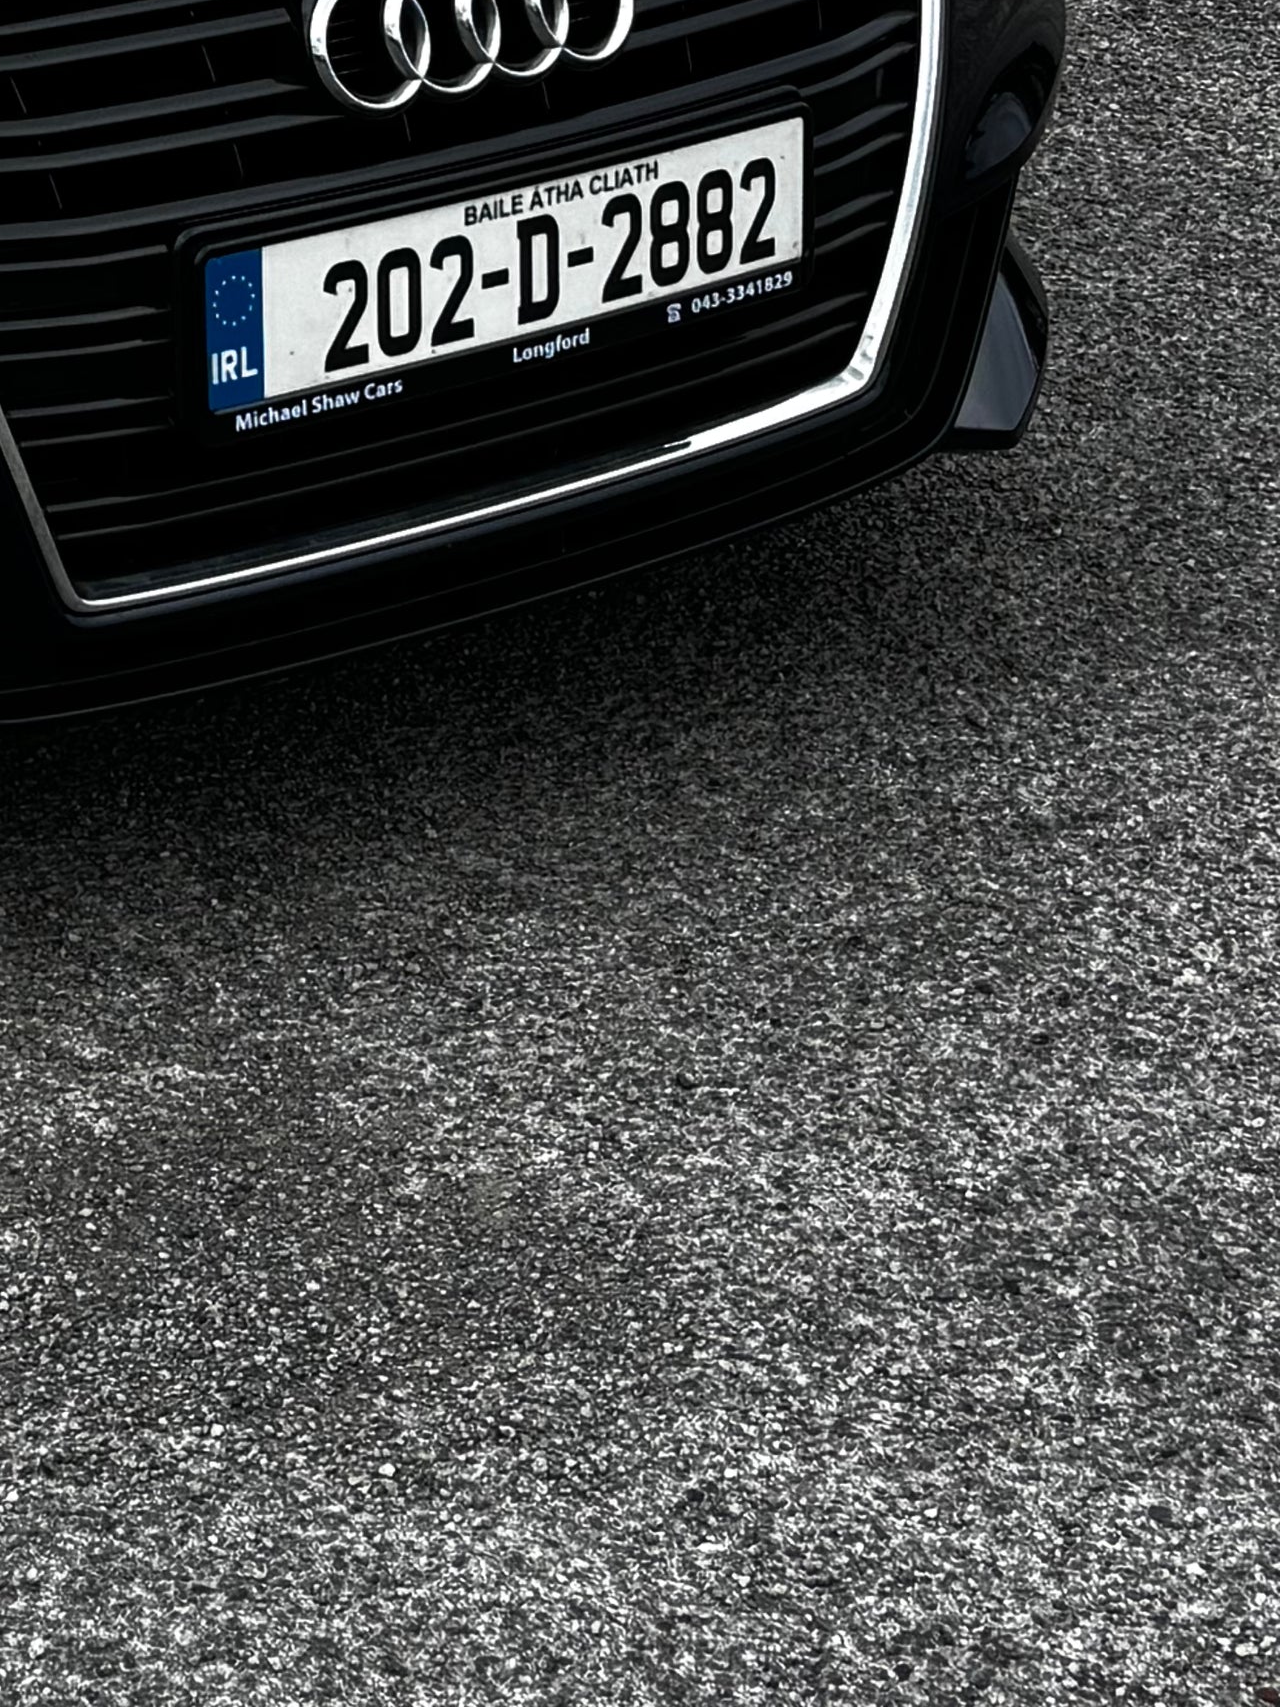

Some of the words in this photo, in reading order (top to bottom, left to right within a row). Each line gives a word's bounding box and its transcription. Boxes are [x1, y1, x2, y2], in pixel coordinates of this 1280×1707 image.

[463, 193, 525, 227] BAILE
[529, 174, 584, 213] ÁTHA
[589, 160, 660, 197] CLIATH
[323, 157, 777, 374] 202-D-2882
[690, 271, 794, 316] 043-3341829
[211, 345, 258, 386] IRL
[512, 328, 591, 365] Longford
[235, 399, 309, 433] Michael
[311, 388, 360, 415] Shaw
[364, 377, 404, 403] Cars
